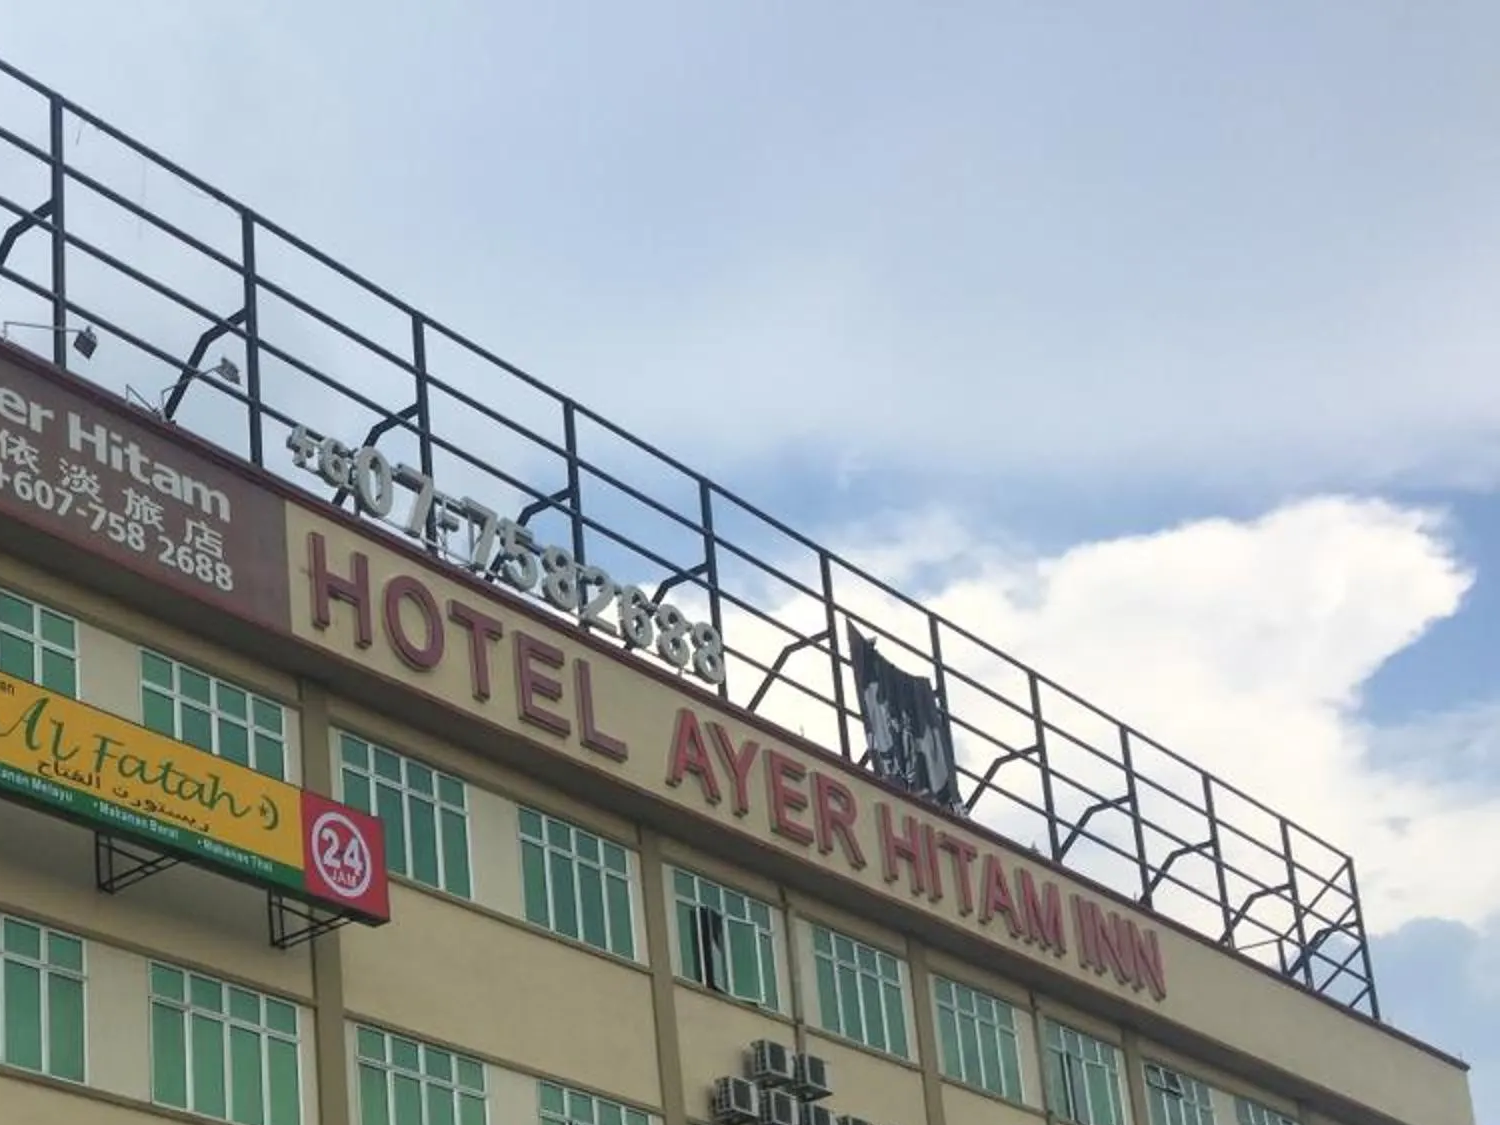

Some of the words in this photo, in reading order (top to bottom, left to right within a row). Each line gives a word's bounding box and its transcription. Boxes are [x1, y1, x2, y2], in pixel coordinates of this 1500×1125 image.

[67, 411, 231, 523] Hitam
[158, 536, 234, 592] 2688
[93, 734, 251, 817] Fatah
[308, 531, 628, 763] HOTEL
[666, 707, 866, 871] AYER
[876, 802, 1067, 957] HITAM
[1070, 894, 1166, 1001] INN
[321, 827, 363, 876] 24
[331, 868, 358, 886] JAM
